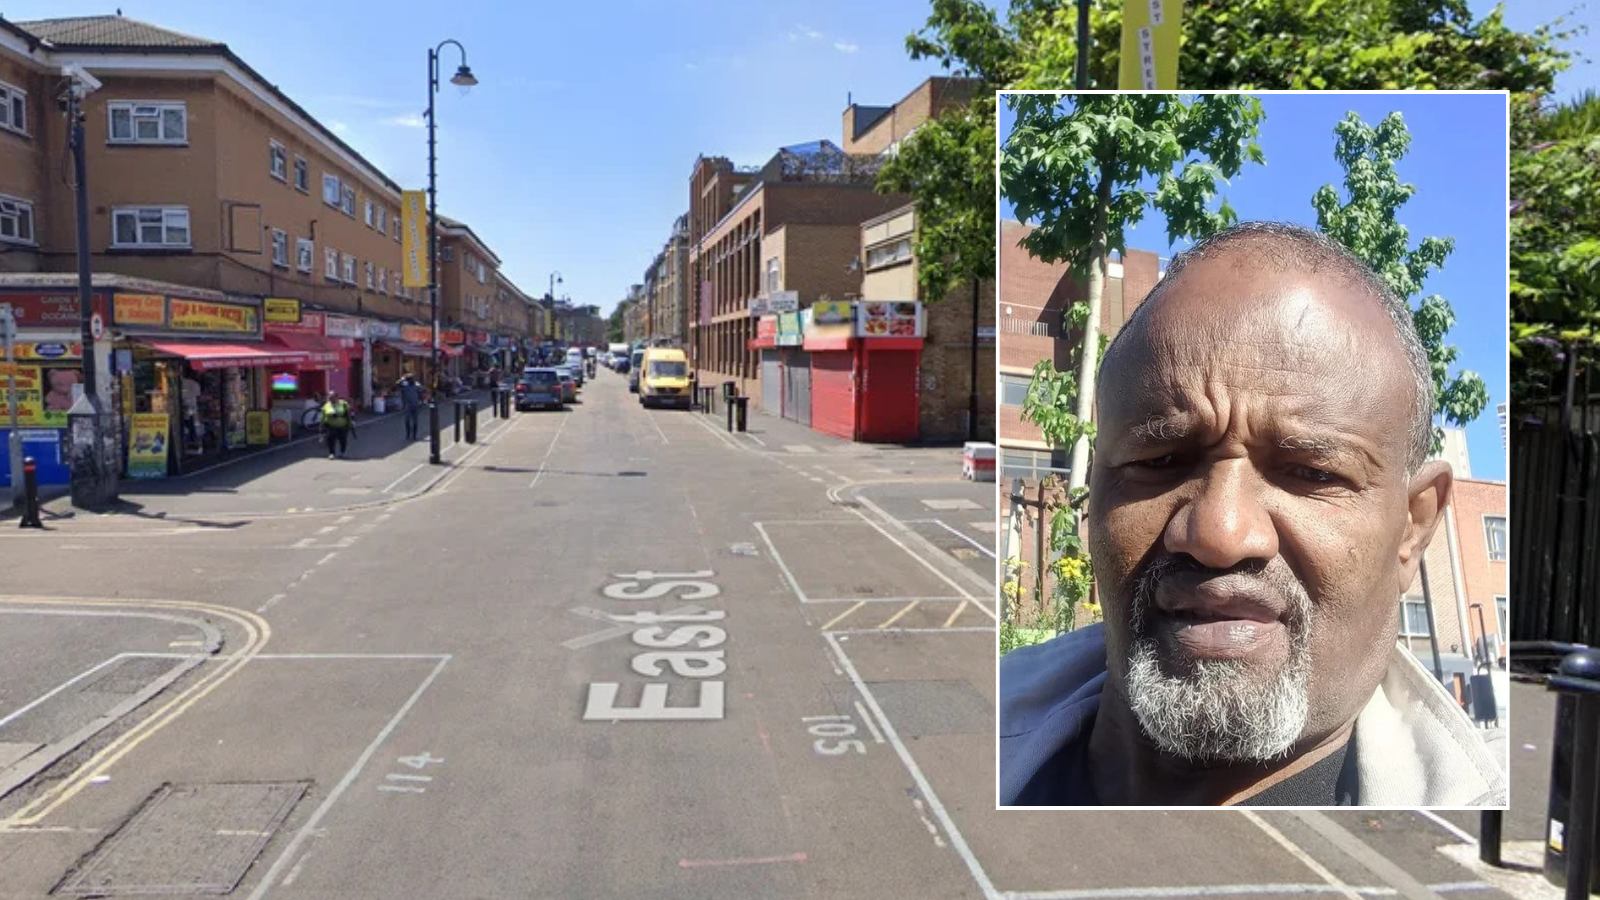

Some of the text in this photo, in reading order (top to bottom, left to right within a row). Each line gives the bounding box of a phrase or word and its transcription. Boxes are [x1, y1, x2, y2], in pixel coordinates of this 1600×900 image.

[1141, 0, 1161, 90] ST STREE
[582, 570, 727, 721] East St
[801, 715, 868, 755] 105
[377, 751, 445, 793] 114
